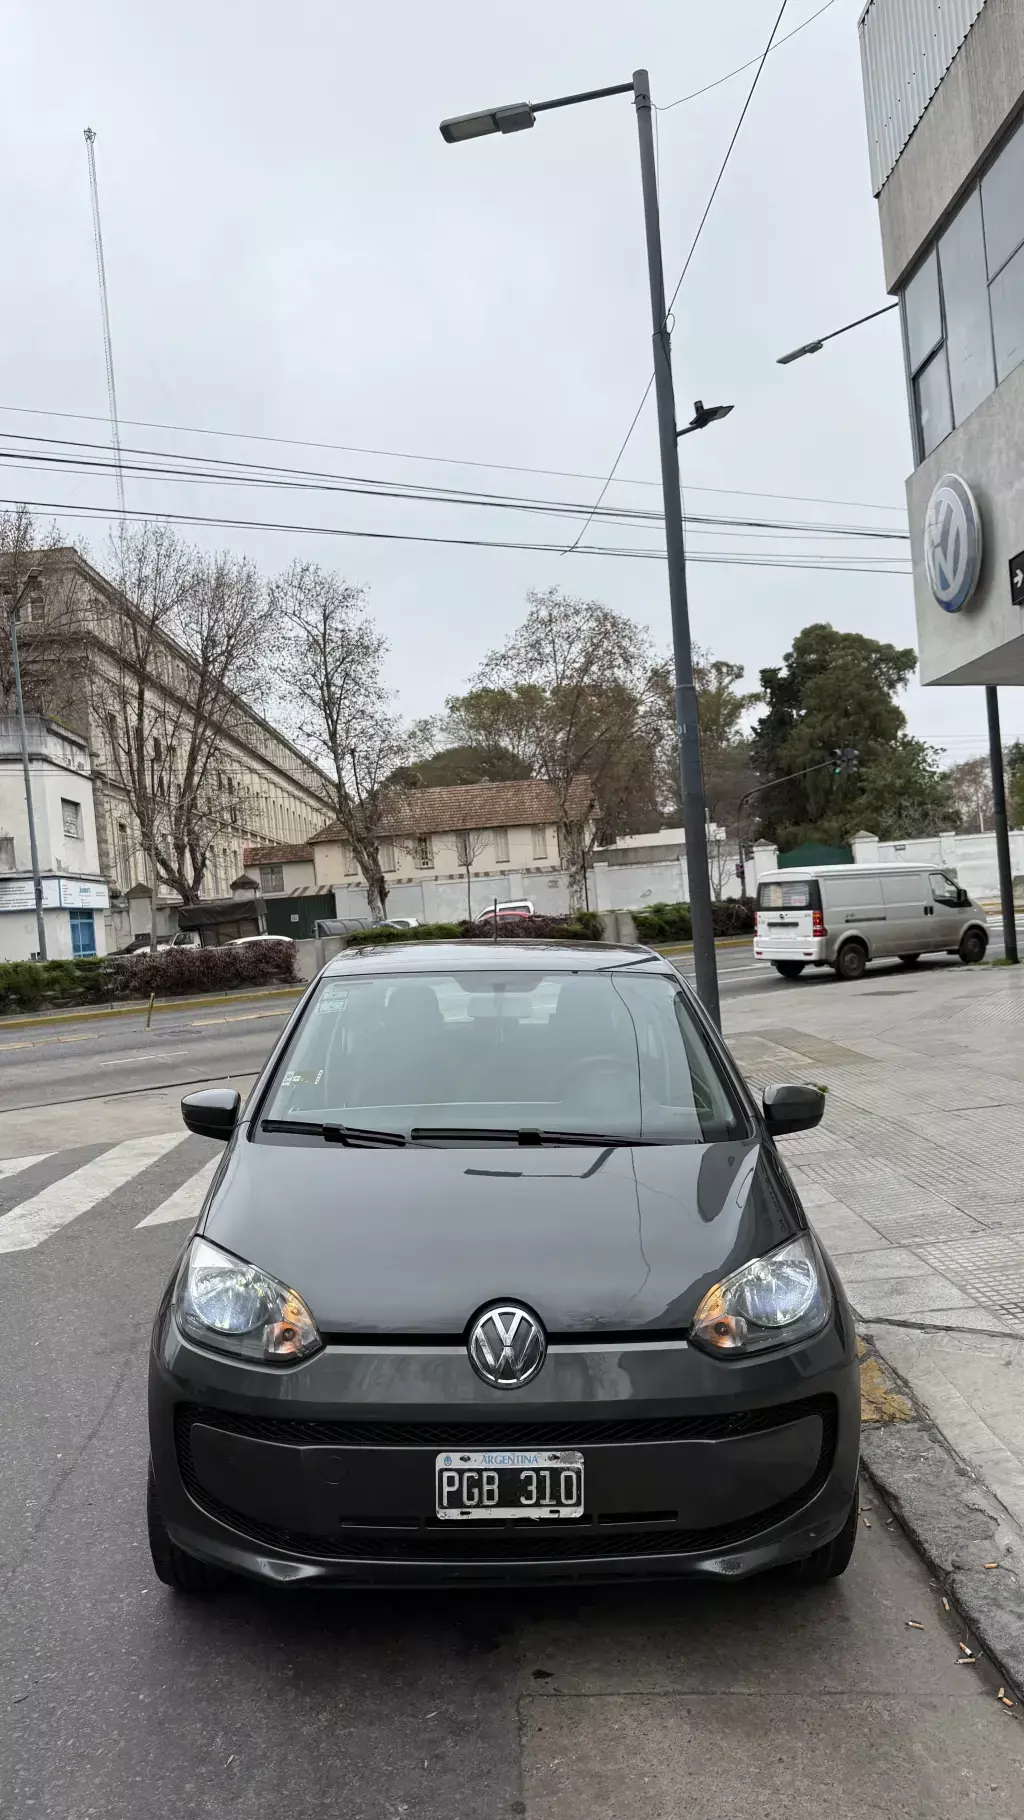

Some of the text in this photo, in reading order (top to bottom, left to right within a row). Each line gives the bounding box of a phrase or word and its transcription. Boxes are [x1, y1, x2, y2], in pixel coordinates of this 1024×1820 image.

[470, 1306, 545, 1385] VW
[480, 1453, 539, 1465] ARGENTINA
[442, 1470, 577, 1507] PGB 310
